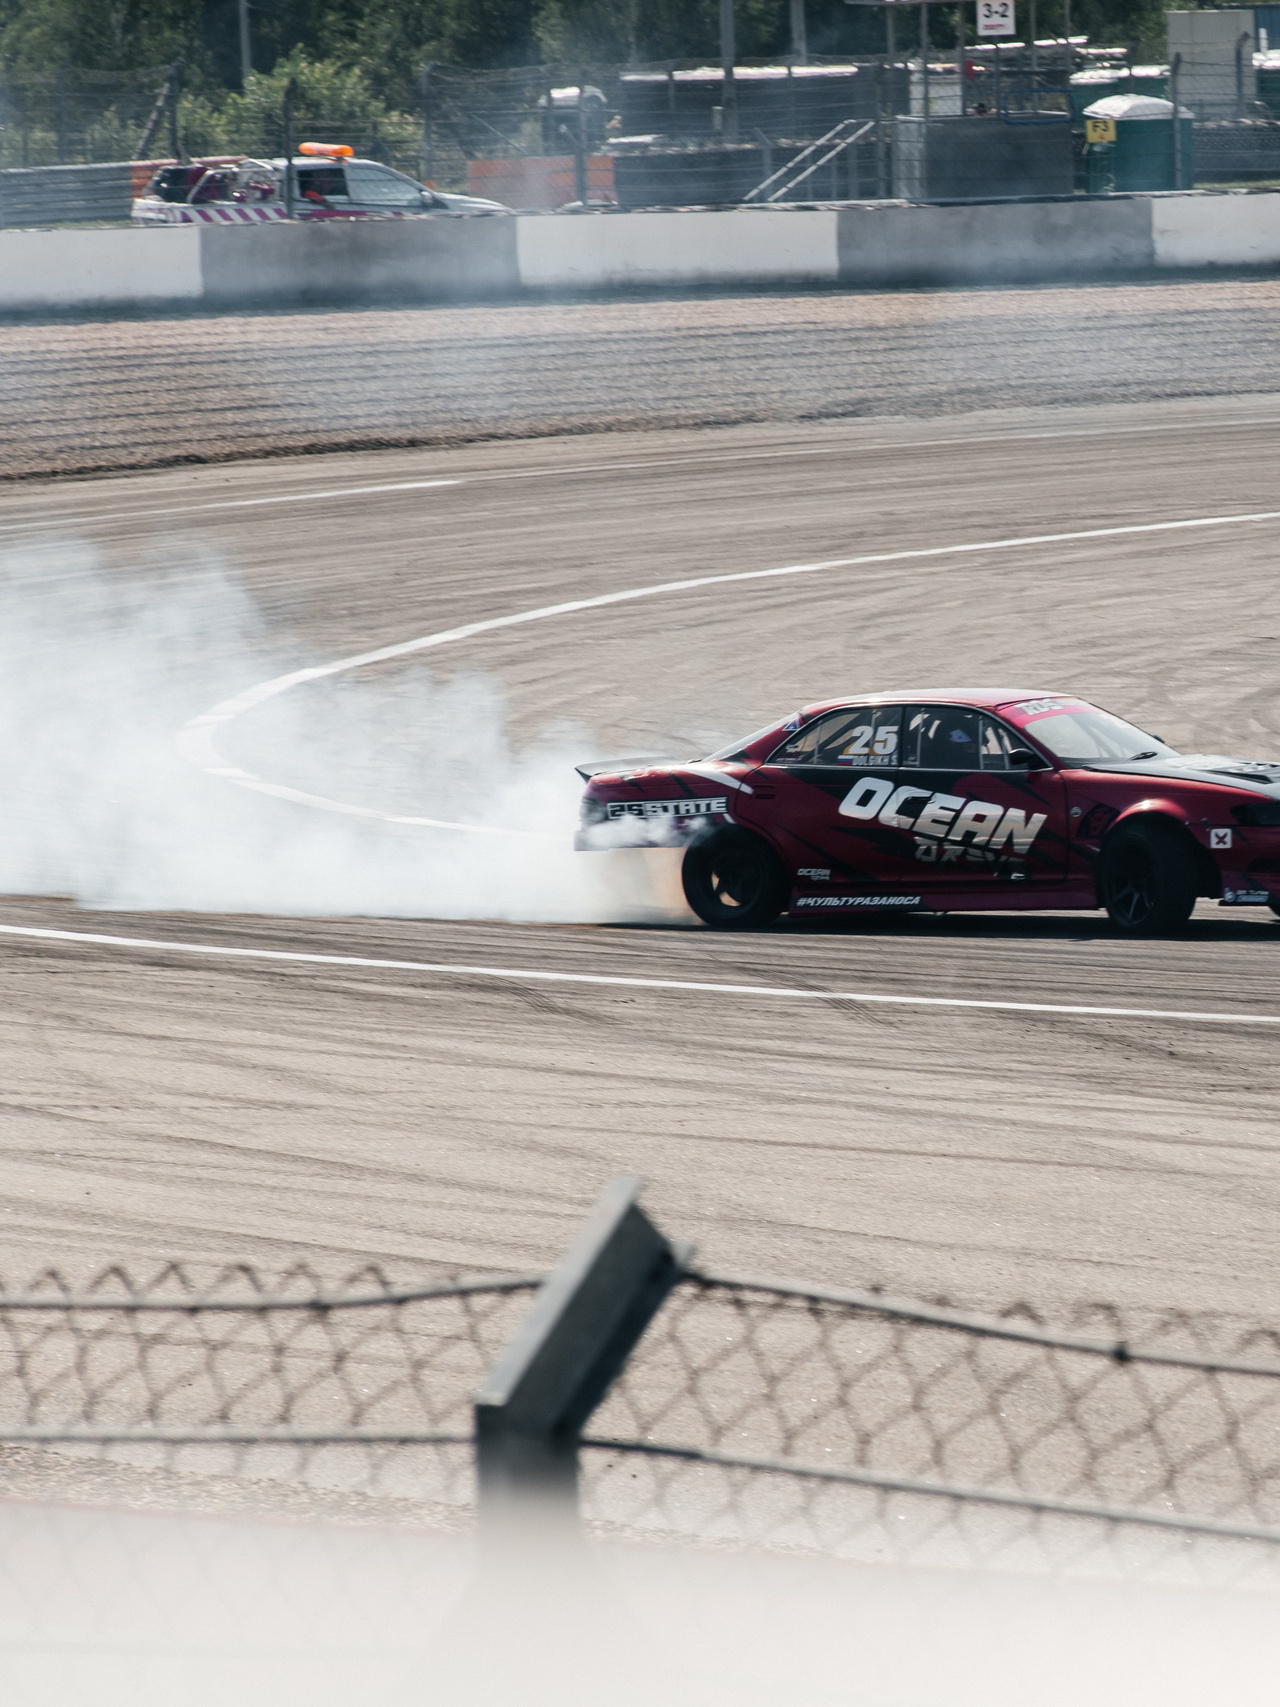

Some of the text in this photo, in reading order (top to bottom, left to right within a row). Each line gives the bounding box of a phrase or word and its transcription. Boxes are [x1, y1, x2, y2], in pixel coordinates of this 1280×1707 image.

[847, 725, 899, 755] 25
[838, 776, 1048, 854] OCEAN
[797, 868, 831, 876] OCEAN
